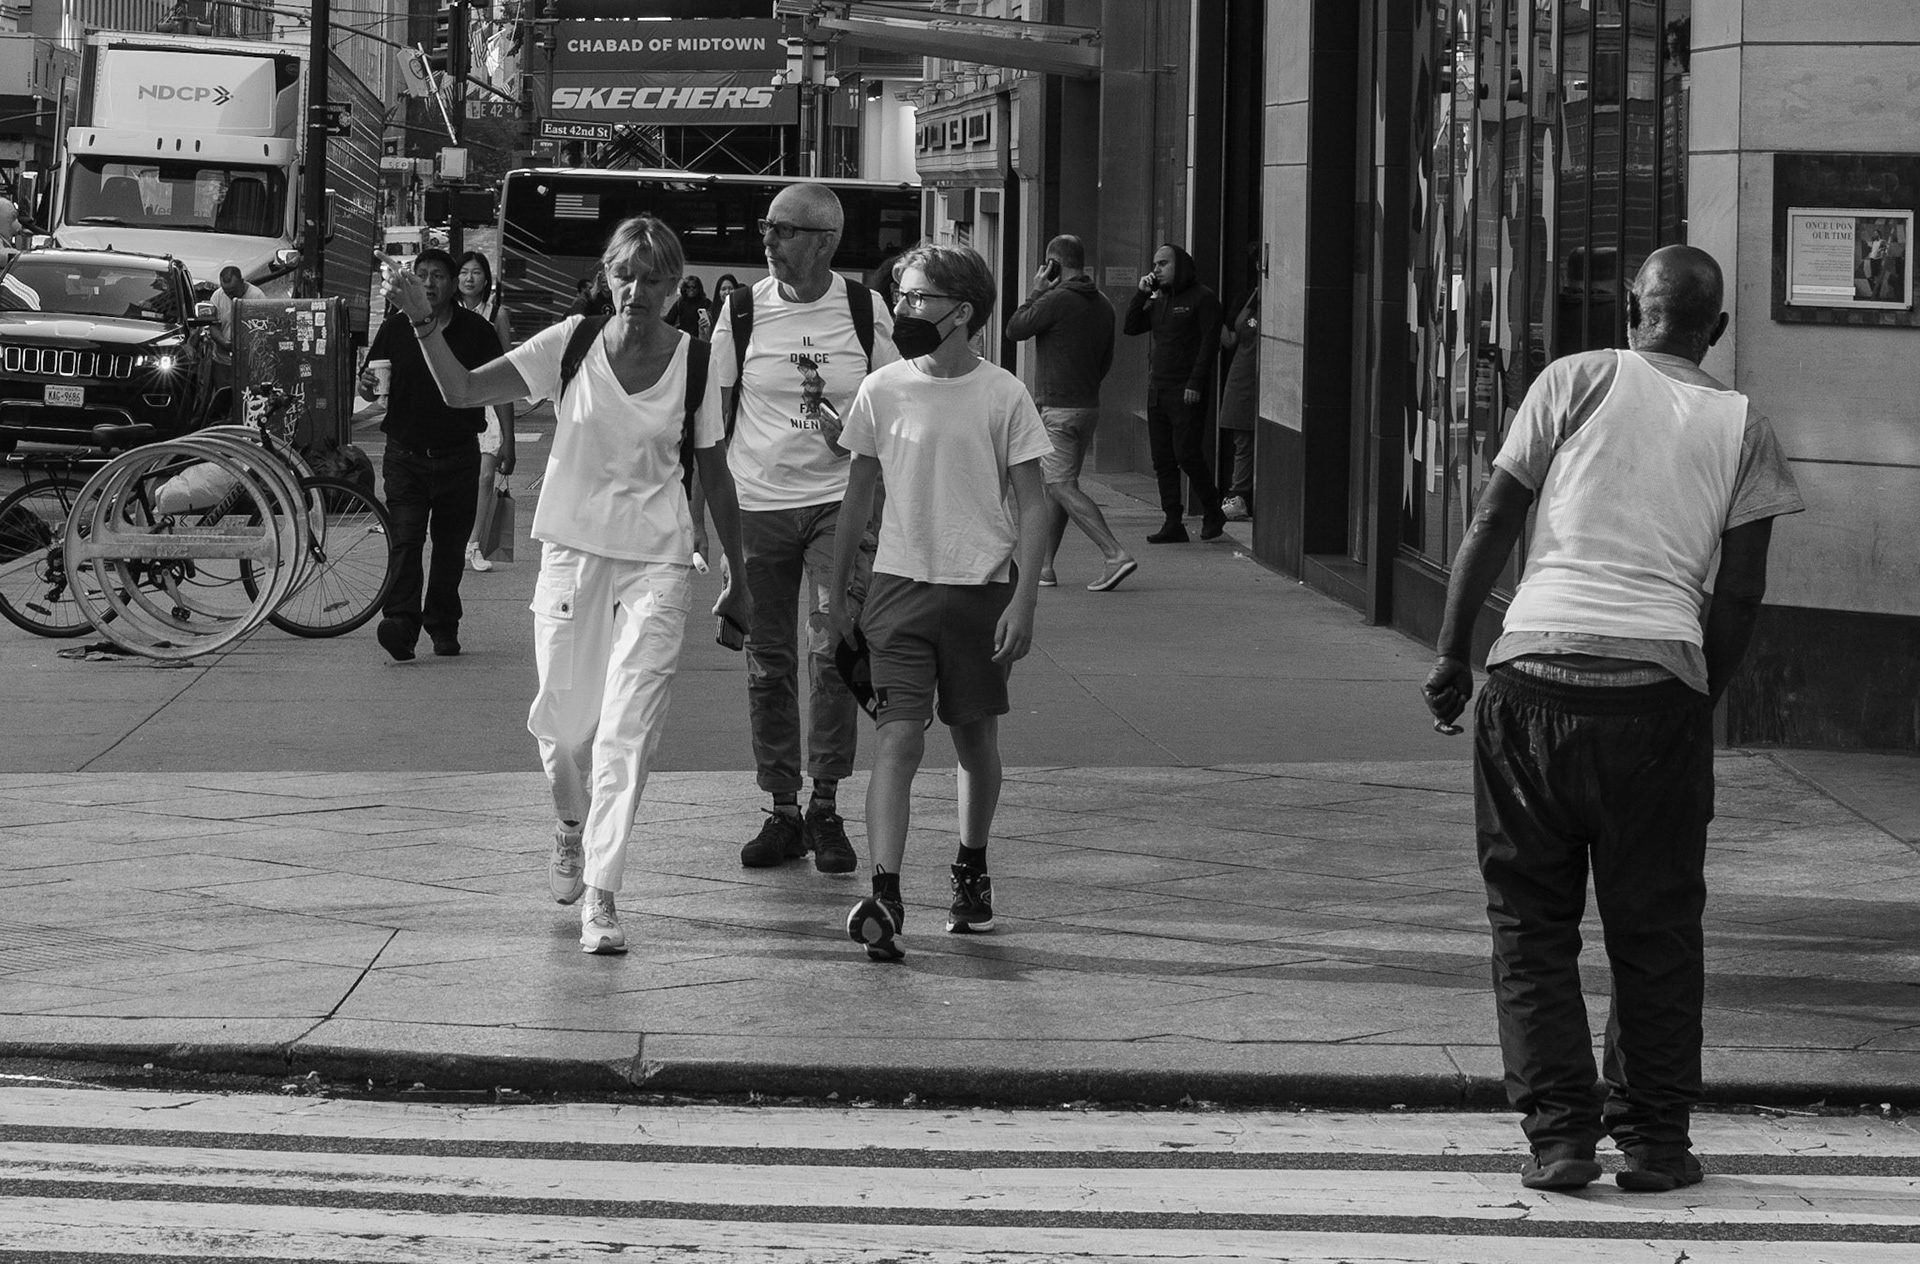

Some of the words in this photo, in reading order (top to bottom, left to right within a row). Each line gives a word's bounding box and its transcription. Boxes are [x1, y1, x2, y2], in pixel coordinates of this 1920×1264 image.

[567, 39, 644, 52] CHABAD
[648, 38, 673, 52] OF
[677, 38, 766, 52] MIDTOWN
[138, 84, 211, 102] NDCP
[551, 86, 775, 109] SKECHERS
[480, 103, 487, 117] E
[490, 103, 503, 118] 42
[544, 123, 567, 135] East
[569, 125, 595, 137] 42nd
[596, 126, 609, 138] St
[1805, 220, 1829, 230] ONCE
[1830, 221, 1853, 230] UPON
[1812, 231, 1830, 240] OUR
[1832, 231, 1853, 241] TIME
[802, 336, 815, 347] IL
[790, 418, 819, 430] NIEN
